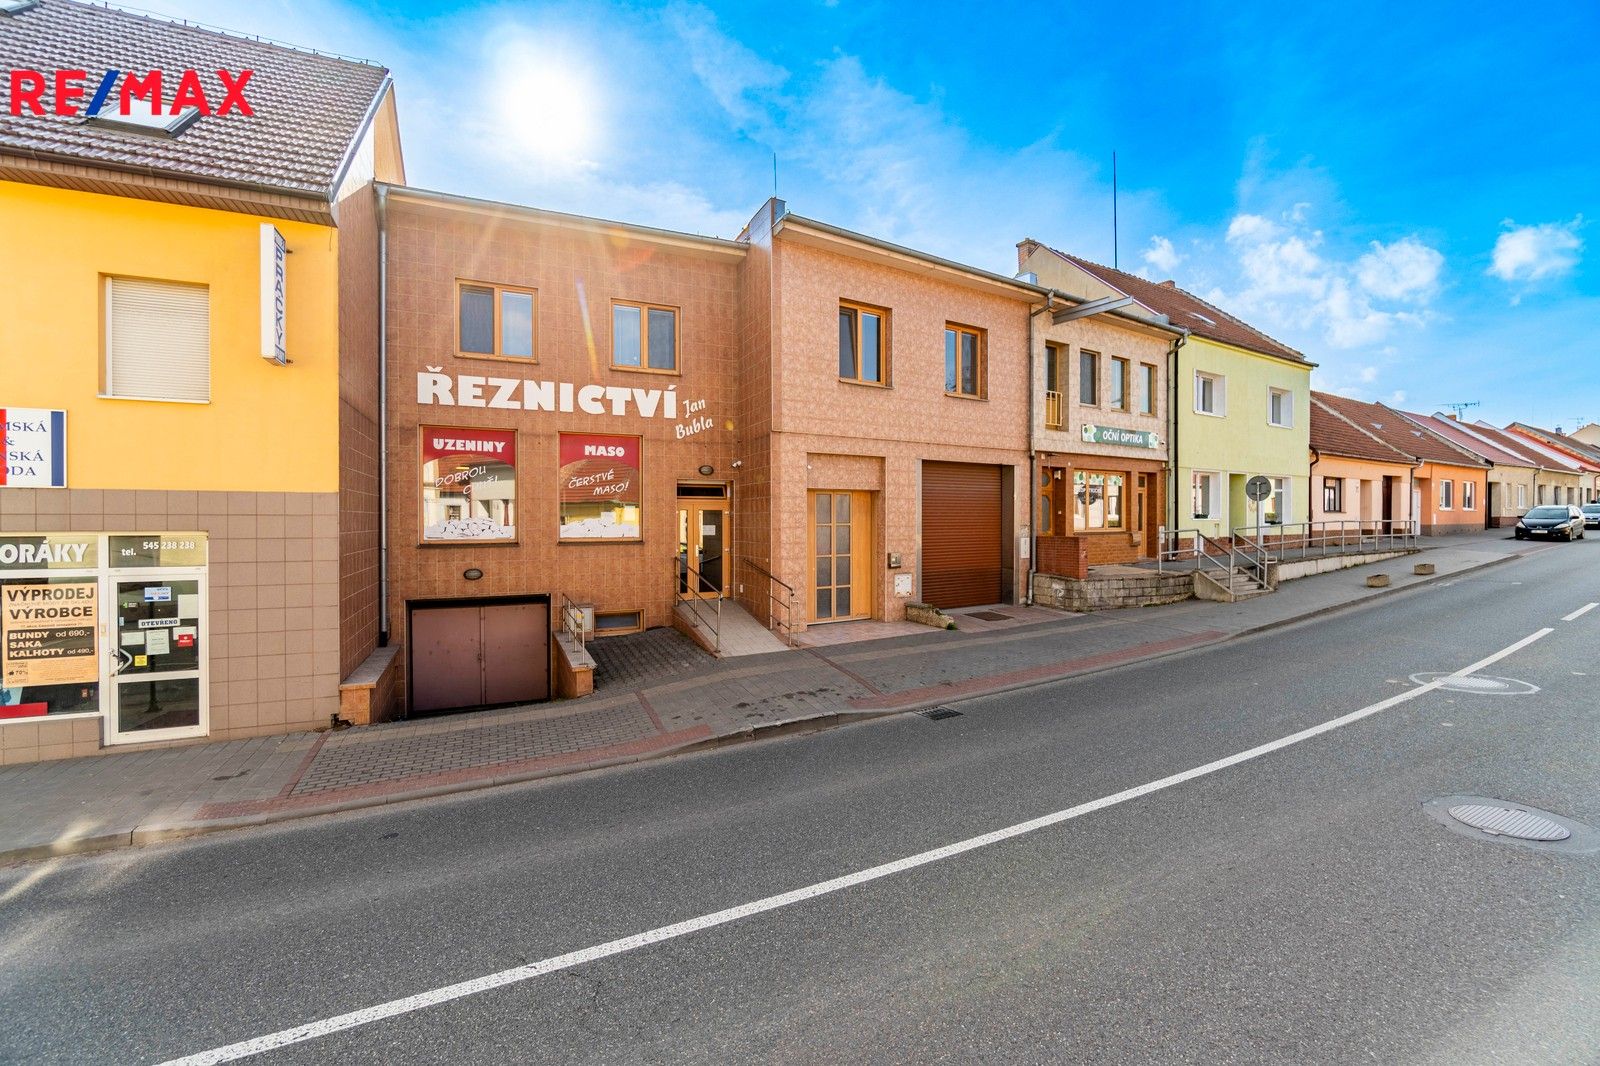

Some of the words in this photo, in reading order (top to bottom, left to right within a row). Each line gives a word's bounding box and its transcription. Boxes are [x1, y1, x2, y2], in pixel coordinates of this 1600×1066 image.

[417, 365, 677, 420] ŘEZNICTVÍ
[682, 399, 706, 419] Jan
[675, 416, 714, 440] Bubla
[1102, 429, 1120, 441] OČNÍ
[1120, 433, 1143, 444] OPTIKA
[433, 438, 506, 453] UZENINY
[584, 445, 625, 457] MASO
[435, 465, 487, 488] DOBROU
[568, 468, 615, 489] ČERSTVÉ
[593, 480, 629, 496] MASO!
[0, 540, 88, 564] ORÁKY
[121, 548, 137, 556] tel.
[143, 541, 160, 550] 545
[7, 586, 94, 602] VÝPRODEJ
[9, 605, 93, 620] VÝROBCE
[141, 619, 178, 627] OTEVŘENO
[9, 631, 50, 640] BUNDY
[56, 630, 67, 638] od
[9, 641, 43, 649] SAKA
[9, 648, 65, 658] KALHOTY
